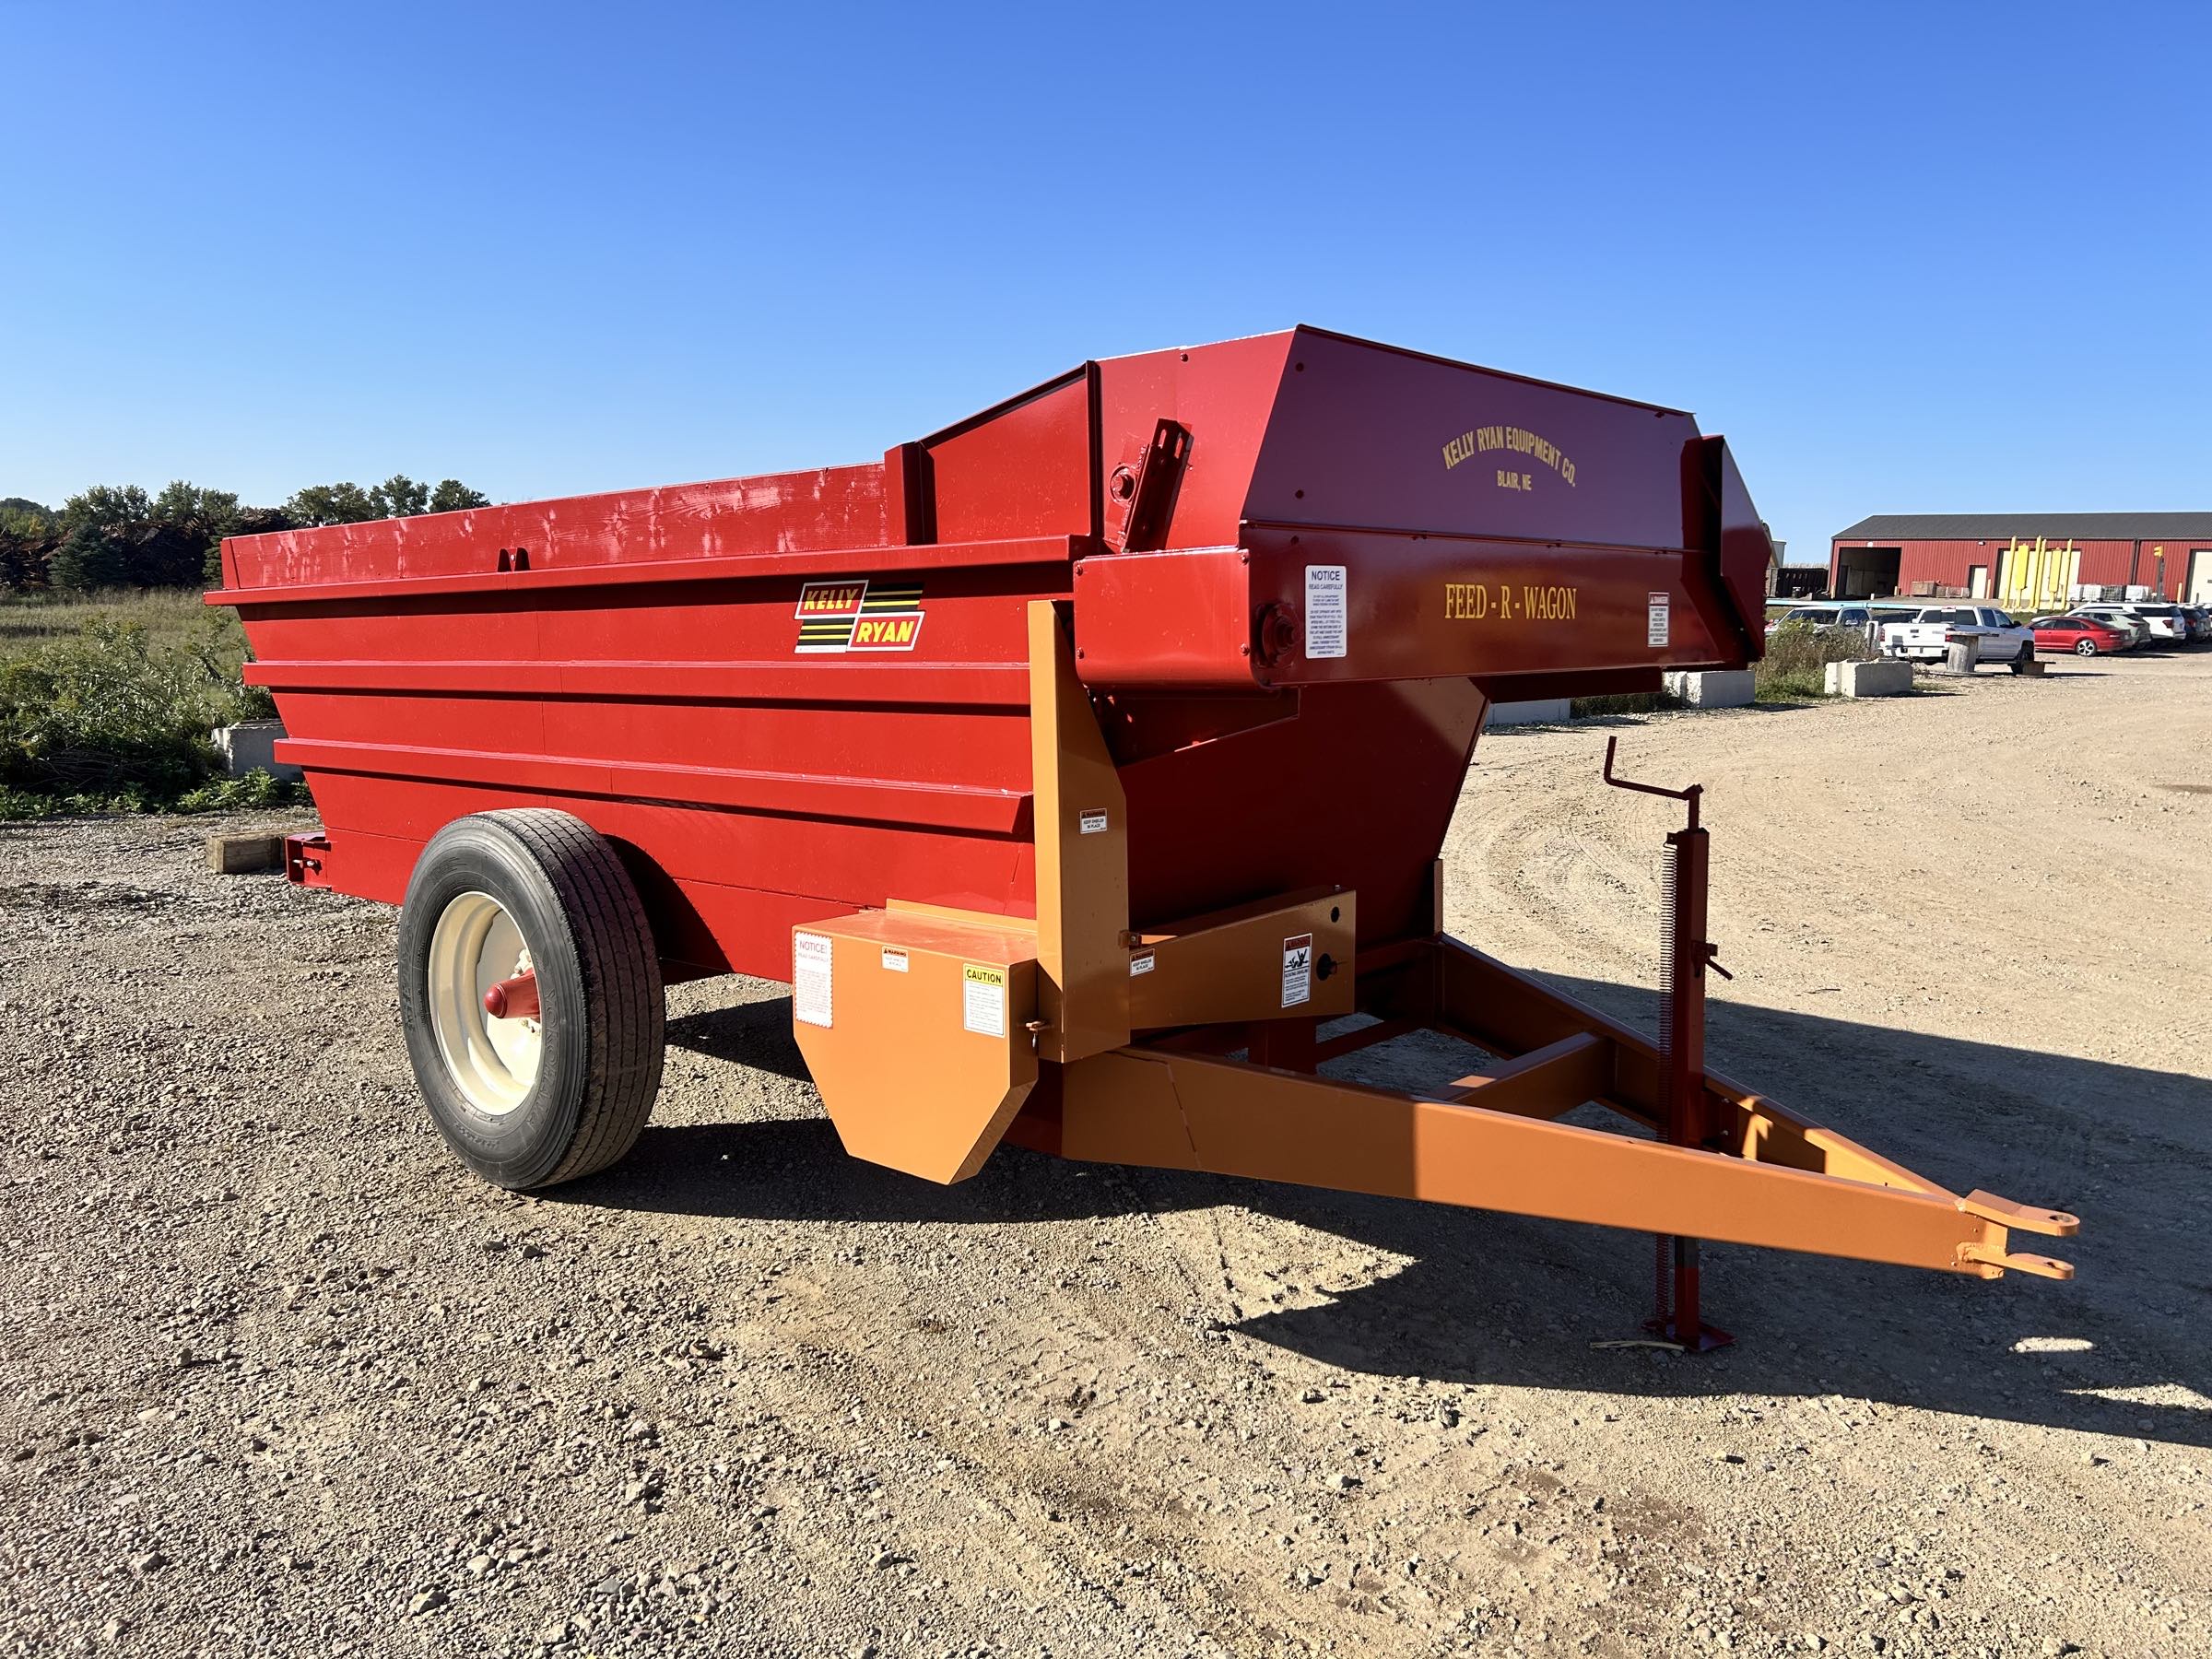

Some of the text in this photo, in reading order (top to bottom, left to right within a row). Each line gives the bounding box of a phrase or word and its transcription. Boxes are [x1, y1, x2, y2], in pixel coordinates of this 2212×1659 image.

[1442, 426, 1576, 487] KELLY RYAN EQUIPMENT CO.
[1497, 470, 1532, 491] BLAIR, NE
[1312, 571, 1340, 581] NOTICE
[1445, 583, 1487, 618] FEED
[1500, 585, 1512, 618] R
[1524, 586, 1577, 619] WAGON
[804, 589, 915, 643] KELLY RYAN
[966, 969, 1002, 984] CAUTION
